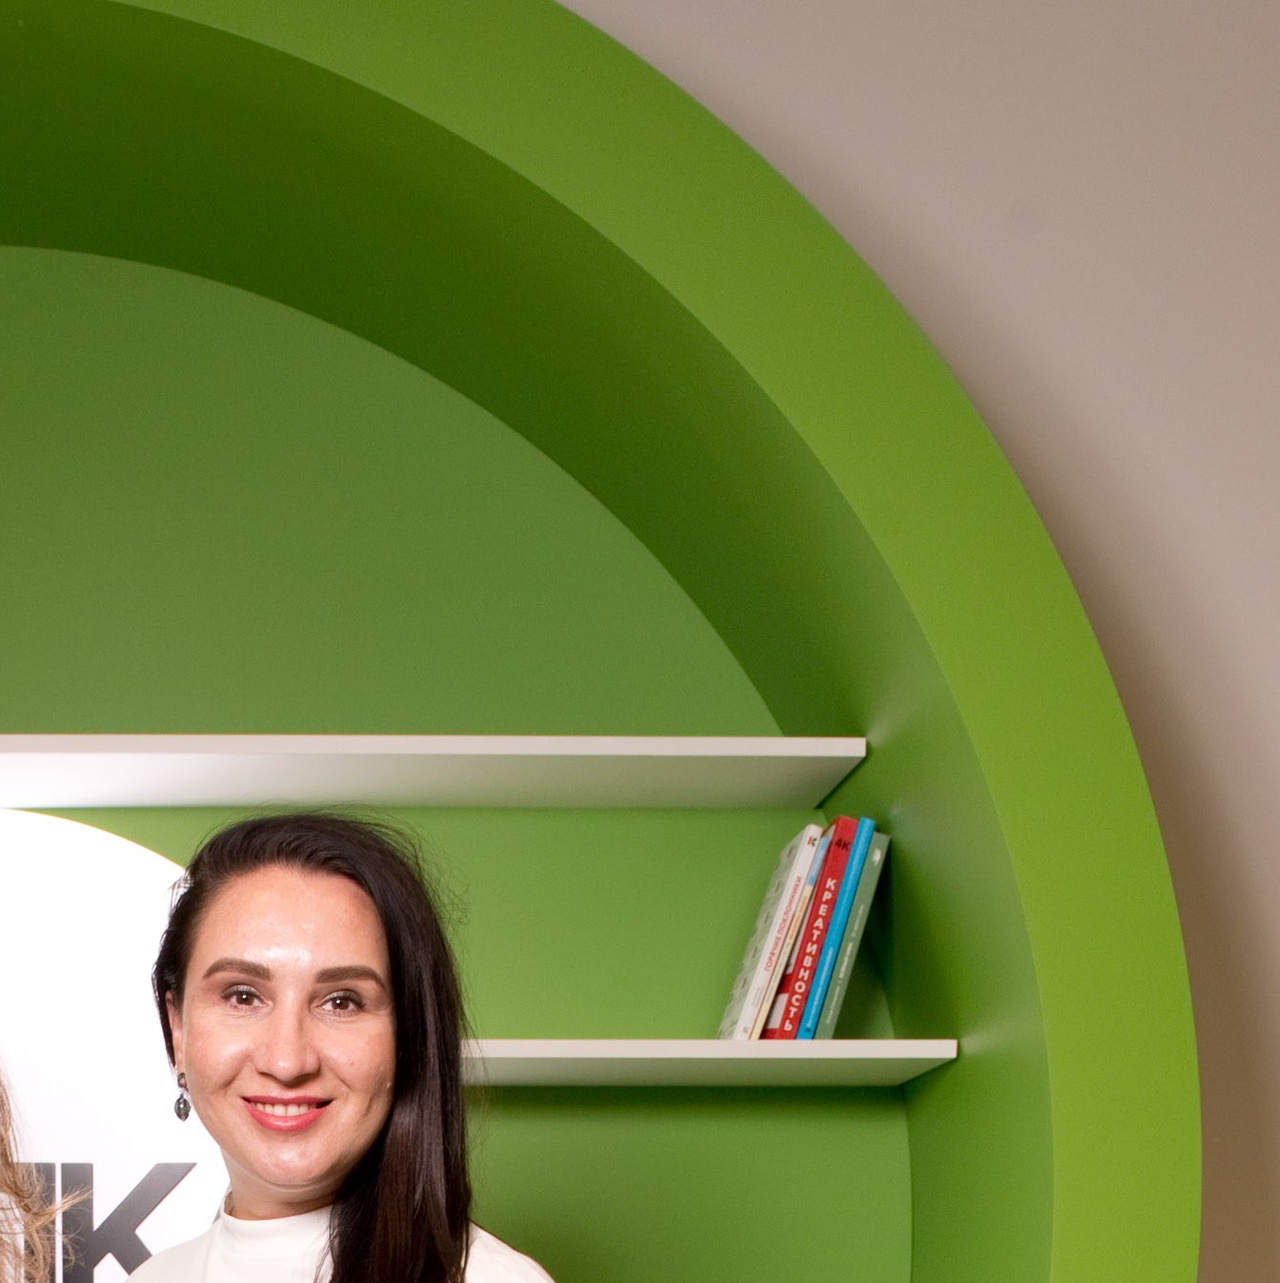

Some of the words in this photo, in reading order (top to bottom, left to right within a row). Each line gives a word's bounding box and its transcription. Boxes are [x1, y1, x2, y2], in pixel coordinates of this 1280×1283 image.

[764, 936, 781, 972] ГОРЯЧИЕ
[777, 876, 803, 935] ПОКЛОННИКИ
[783, 878, 838, 1031] КРЕАТИВНОСТЬ
